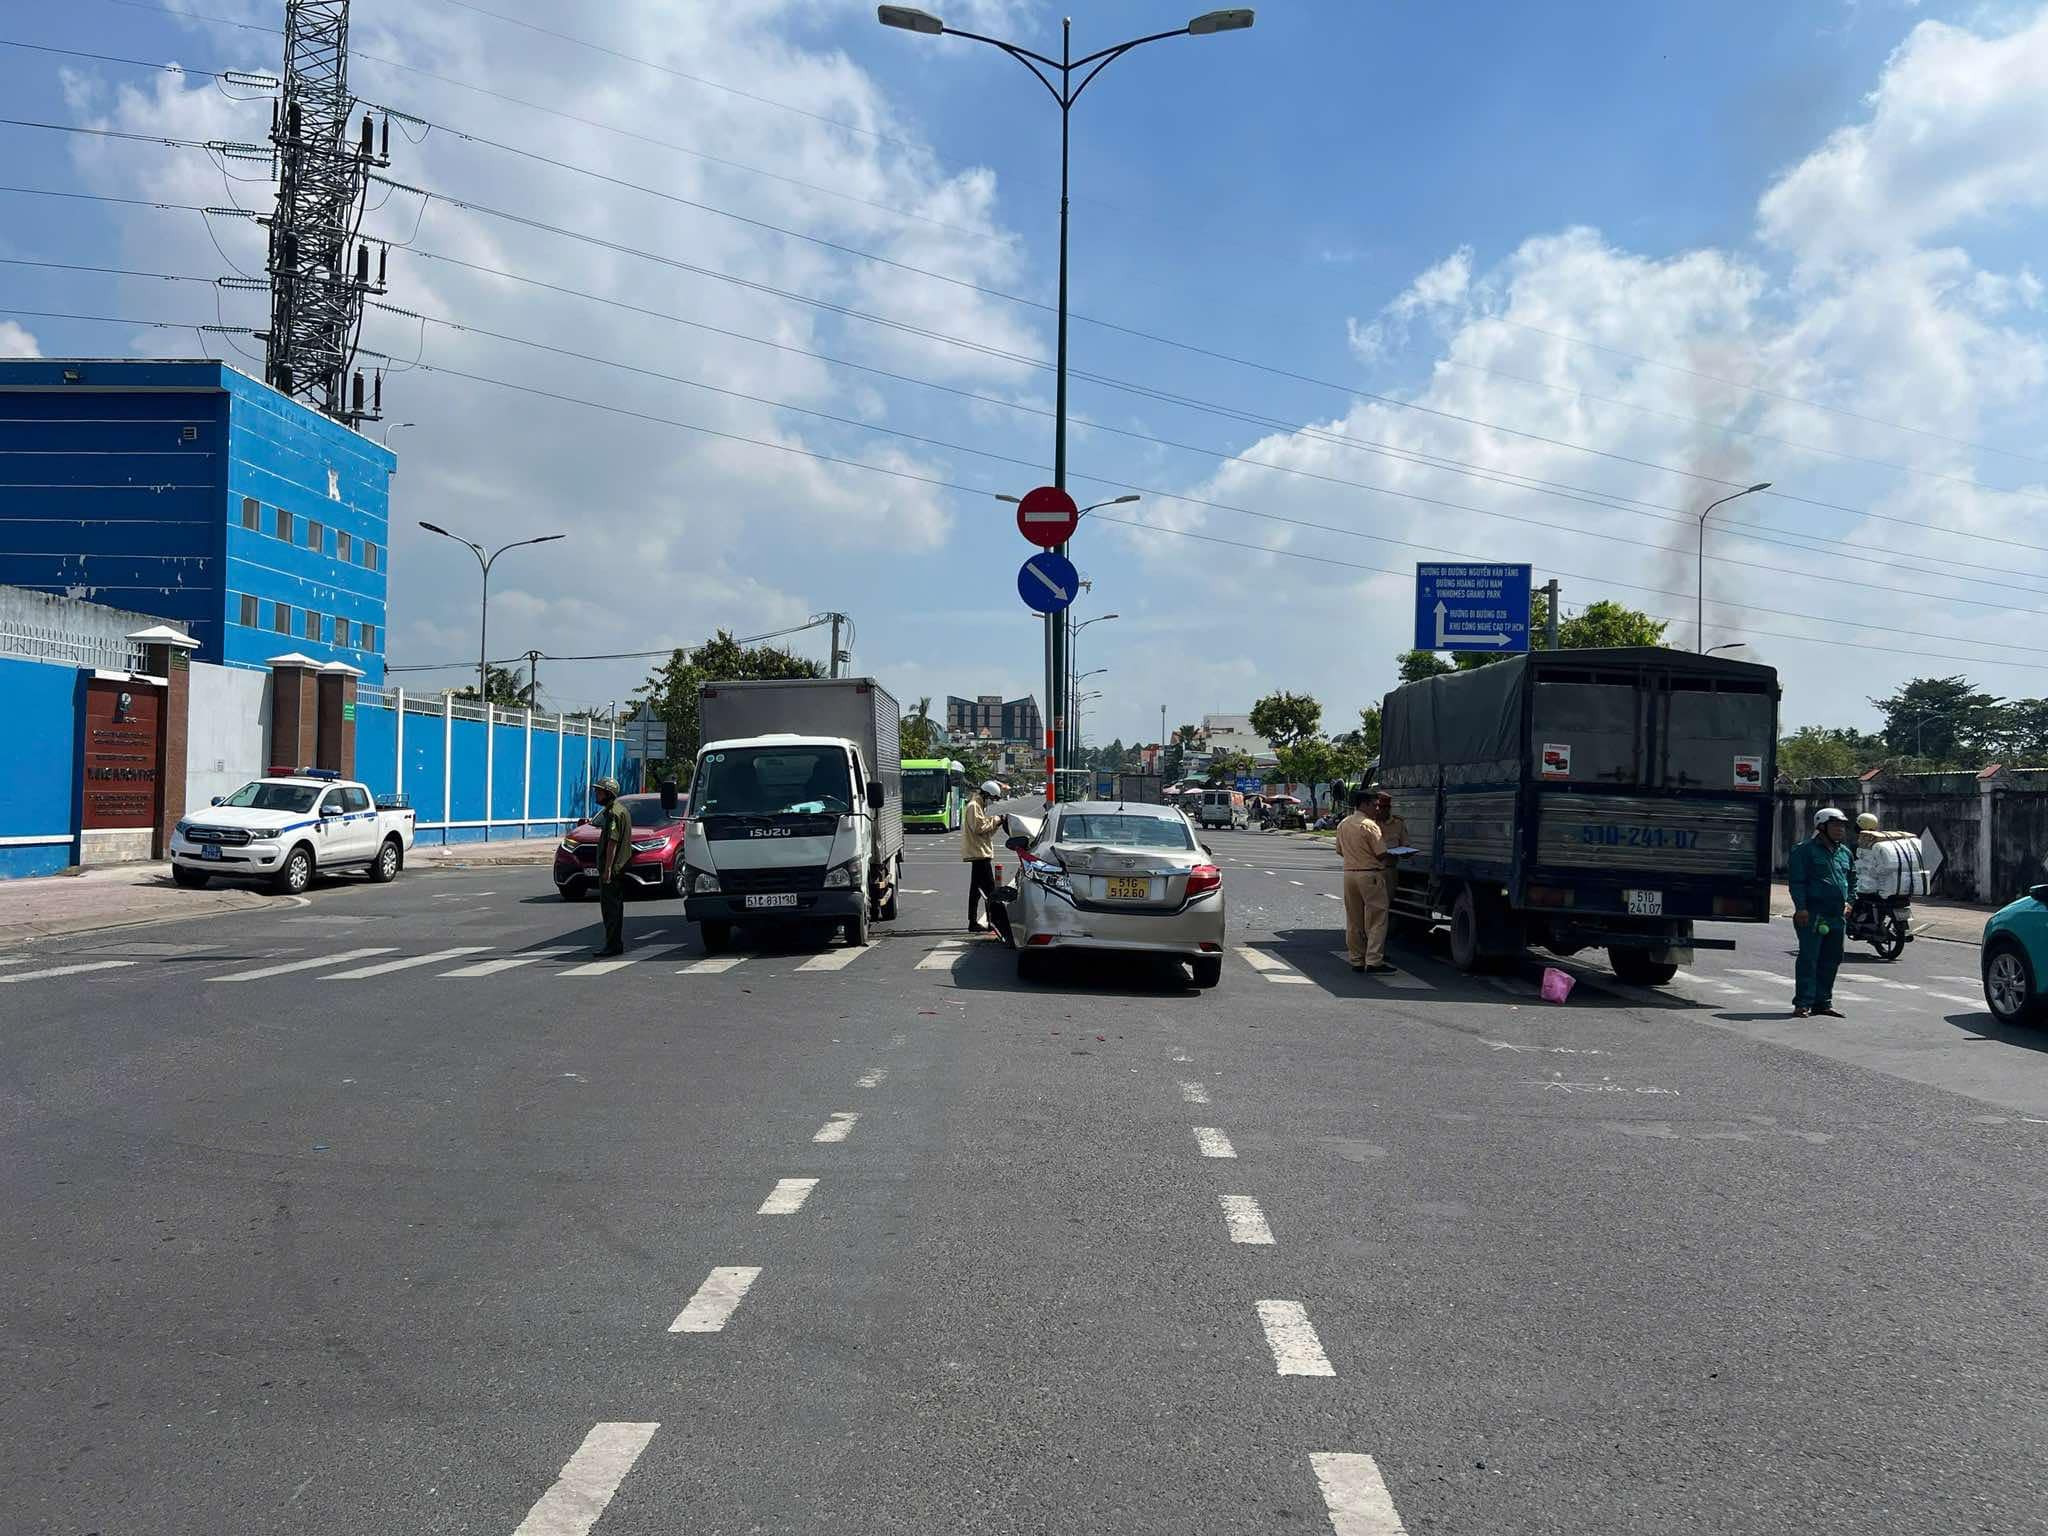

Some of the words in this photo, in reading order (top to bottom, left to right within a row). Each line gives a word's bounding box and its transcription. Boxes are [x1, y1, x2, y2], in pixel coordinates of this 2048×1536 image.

[1490, 579, 1502, 588] NAM
[1437, 589, 1465, 598] VINHOMES
[1466, 589, 1485, 598] GRAND
[1487, 589, 1501, 598] PARK
[1492, 622, 1504, 632] CAO
[750, 828, 791, 837] ISUZU
